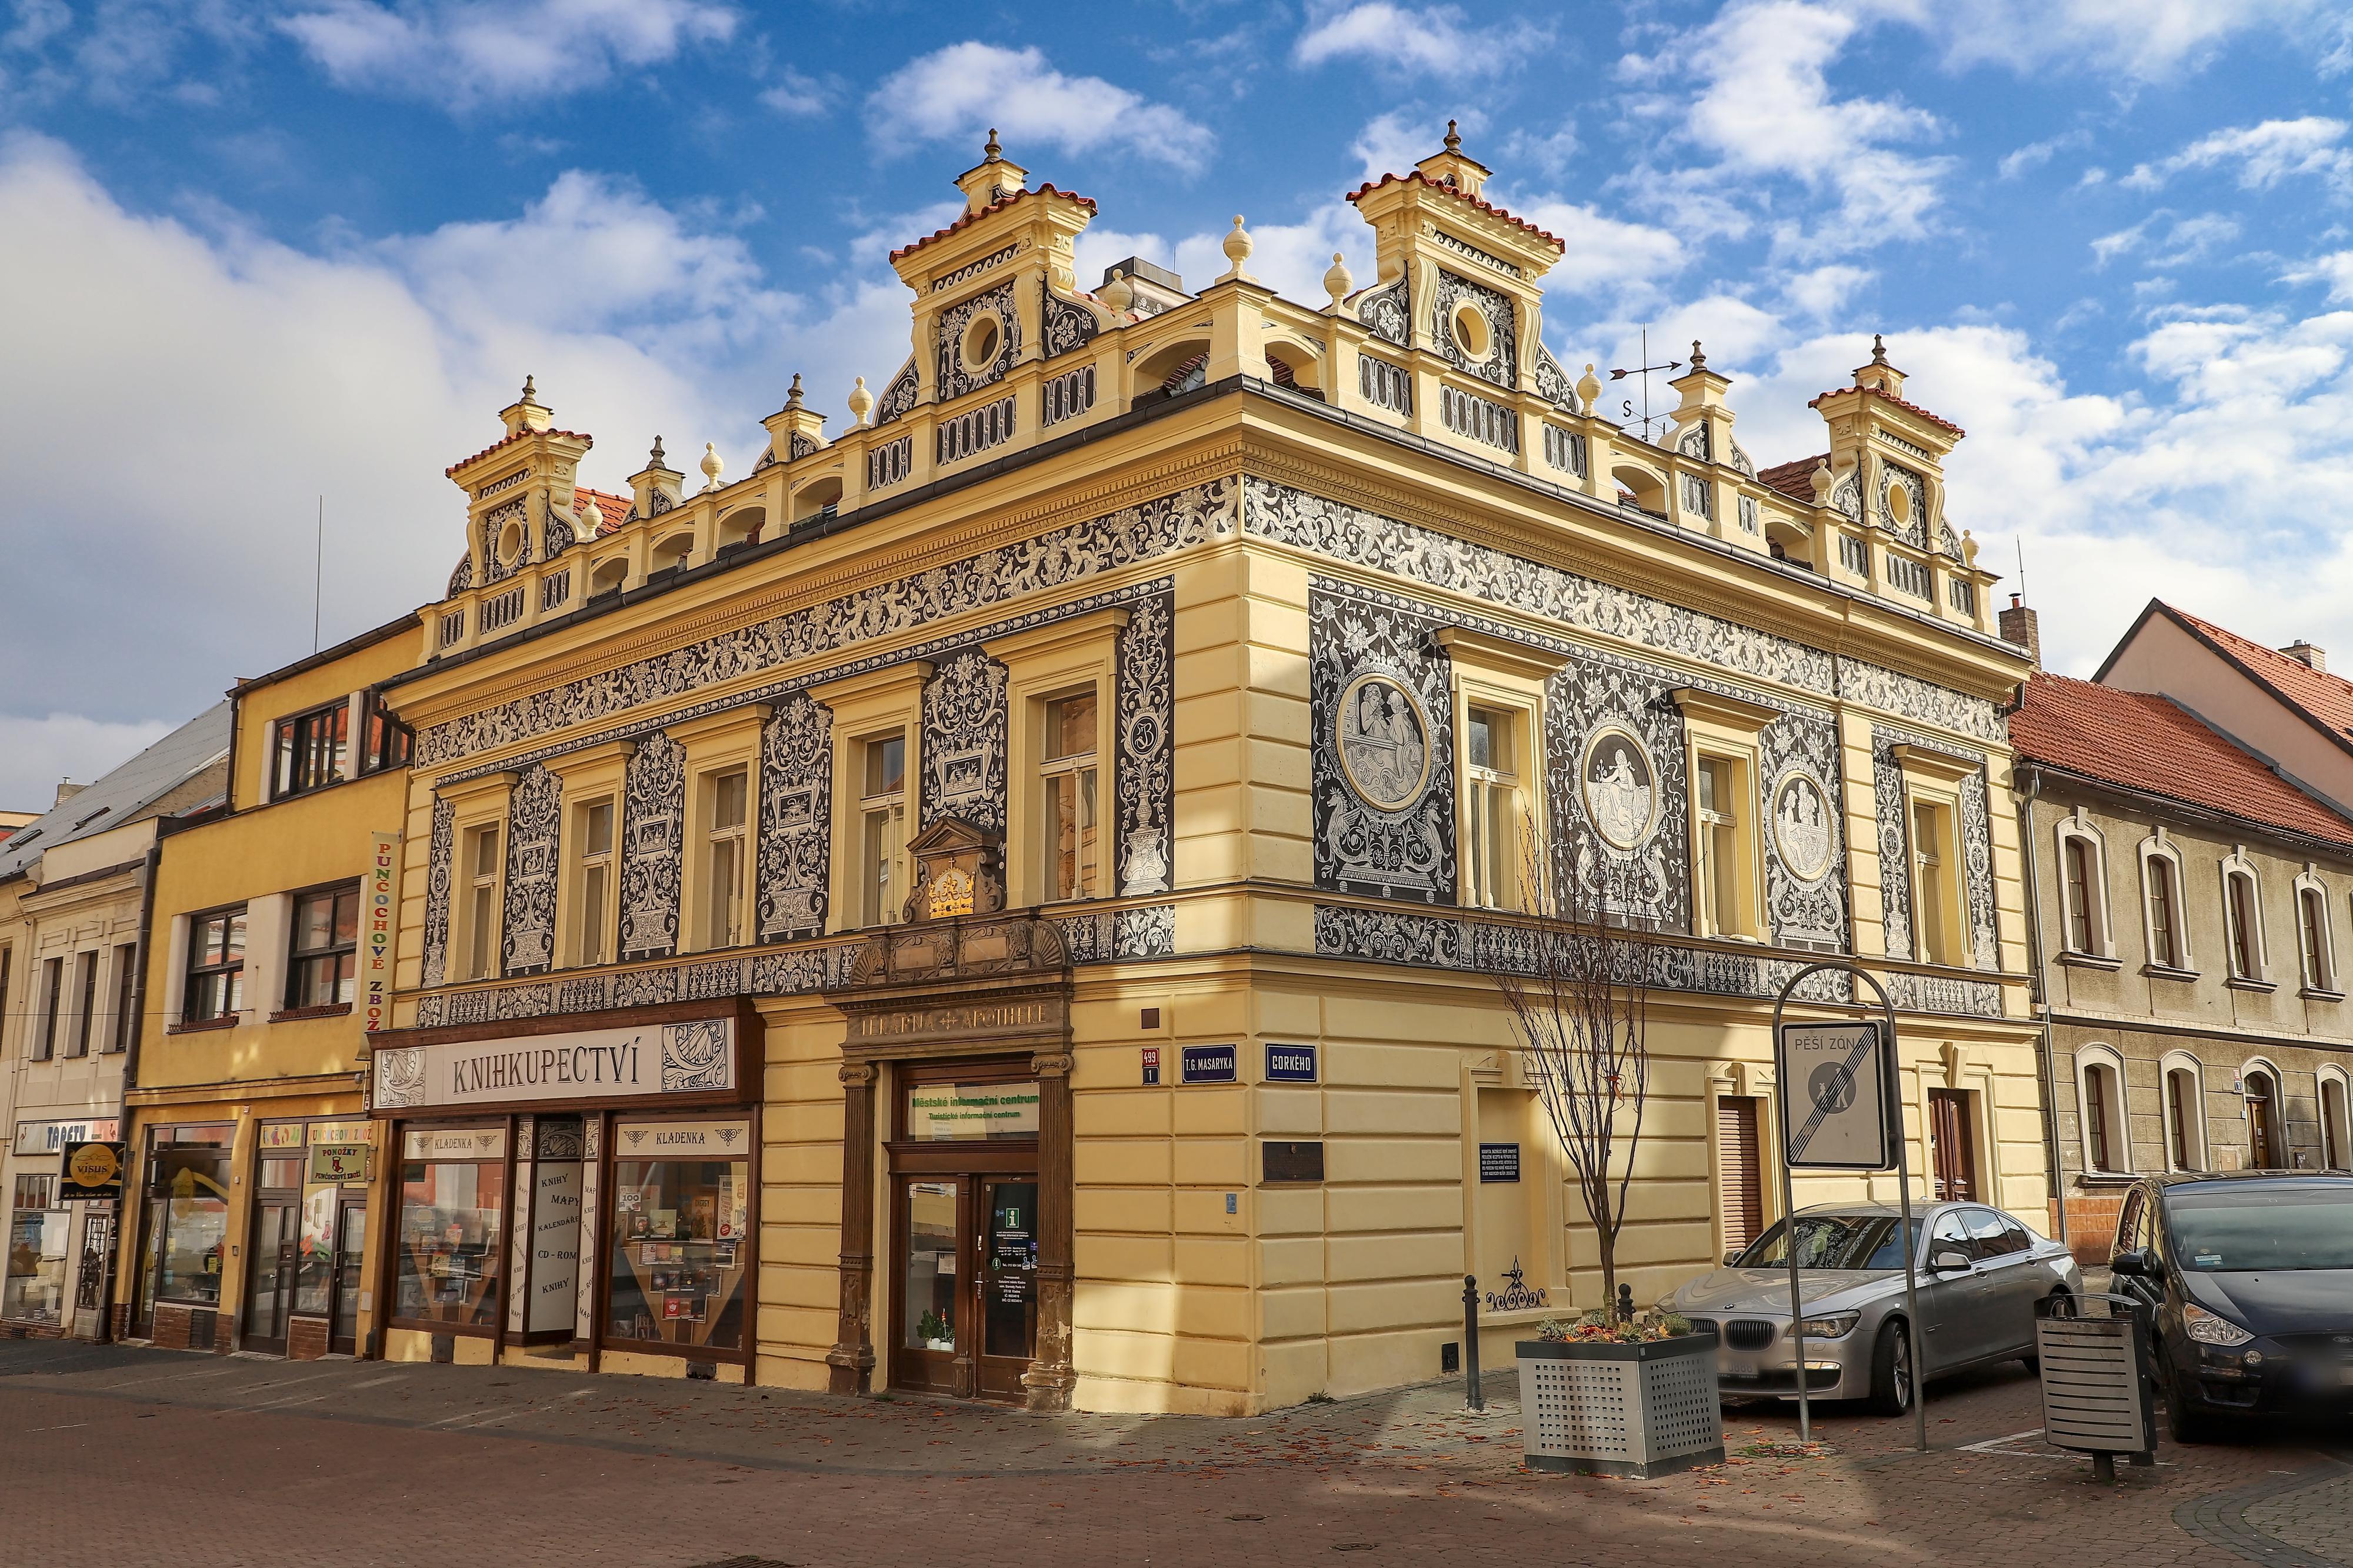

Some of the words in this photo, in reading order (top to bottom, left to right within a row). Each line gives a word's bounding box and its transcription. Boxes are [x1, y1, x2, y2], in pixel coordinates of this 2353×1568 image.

[1623, 400, 1631, 417] S
[371, 843, 391, 970] PUNČOCHOVÉ
[367, 981, 383, 1031] ZBOŽ
[1795, 1035, 1824, 1050] PĚŠÍ
[1144, 1052, 1156, 1063] 499
[1198, 1057, 1233, 1070] MASARYKA
[1272, 1055, 1311, 1071] GORKÉHO
[453, 1036, 642, 1095] KNIHKUPECTVÍ
[1148, 1069, 1152, 1081] 1
[912, 1096, 948, 1107] Městské
[950, 1095, 998, 1106] informační
[1000, 1095, 1039, 1105] centrum
[959, 1111, 992, 1119] informační
[354, 1125, 372, 1140] ZBOŽ
[656, 1132, 705, 1145] KLADENKA
[435, 1138, 472, 1149] KLADENKA
[322, 1147, 358, 1156] PONOŽKY
[77, 1162, 108, 1173] visus
[541, 1173, 568, 1187] KNIHY
[584, 1185, 596, 1194] MAP
[551, 1195, 579, 1206] MAPY
[538, 1216, 579, 1232] KALENDÁŘE
[538, 1250, 549, 1259] CD
[557, 1251, 577, 1259] ROM
[542, 1277, 569, 1293] KNIHY
[579, 1307, 591, 1319] MAP
